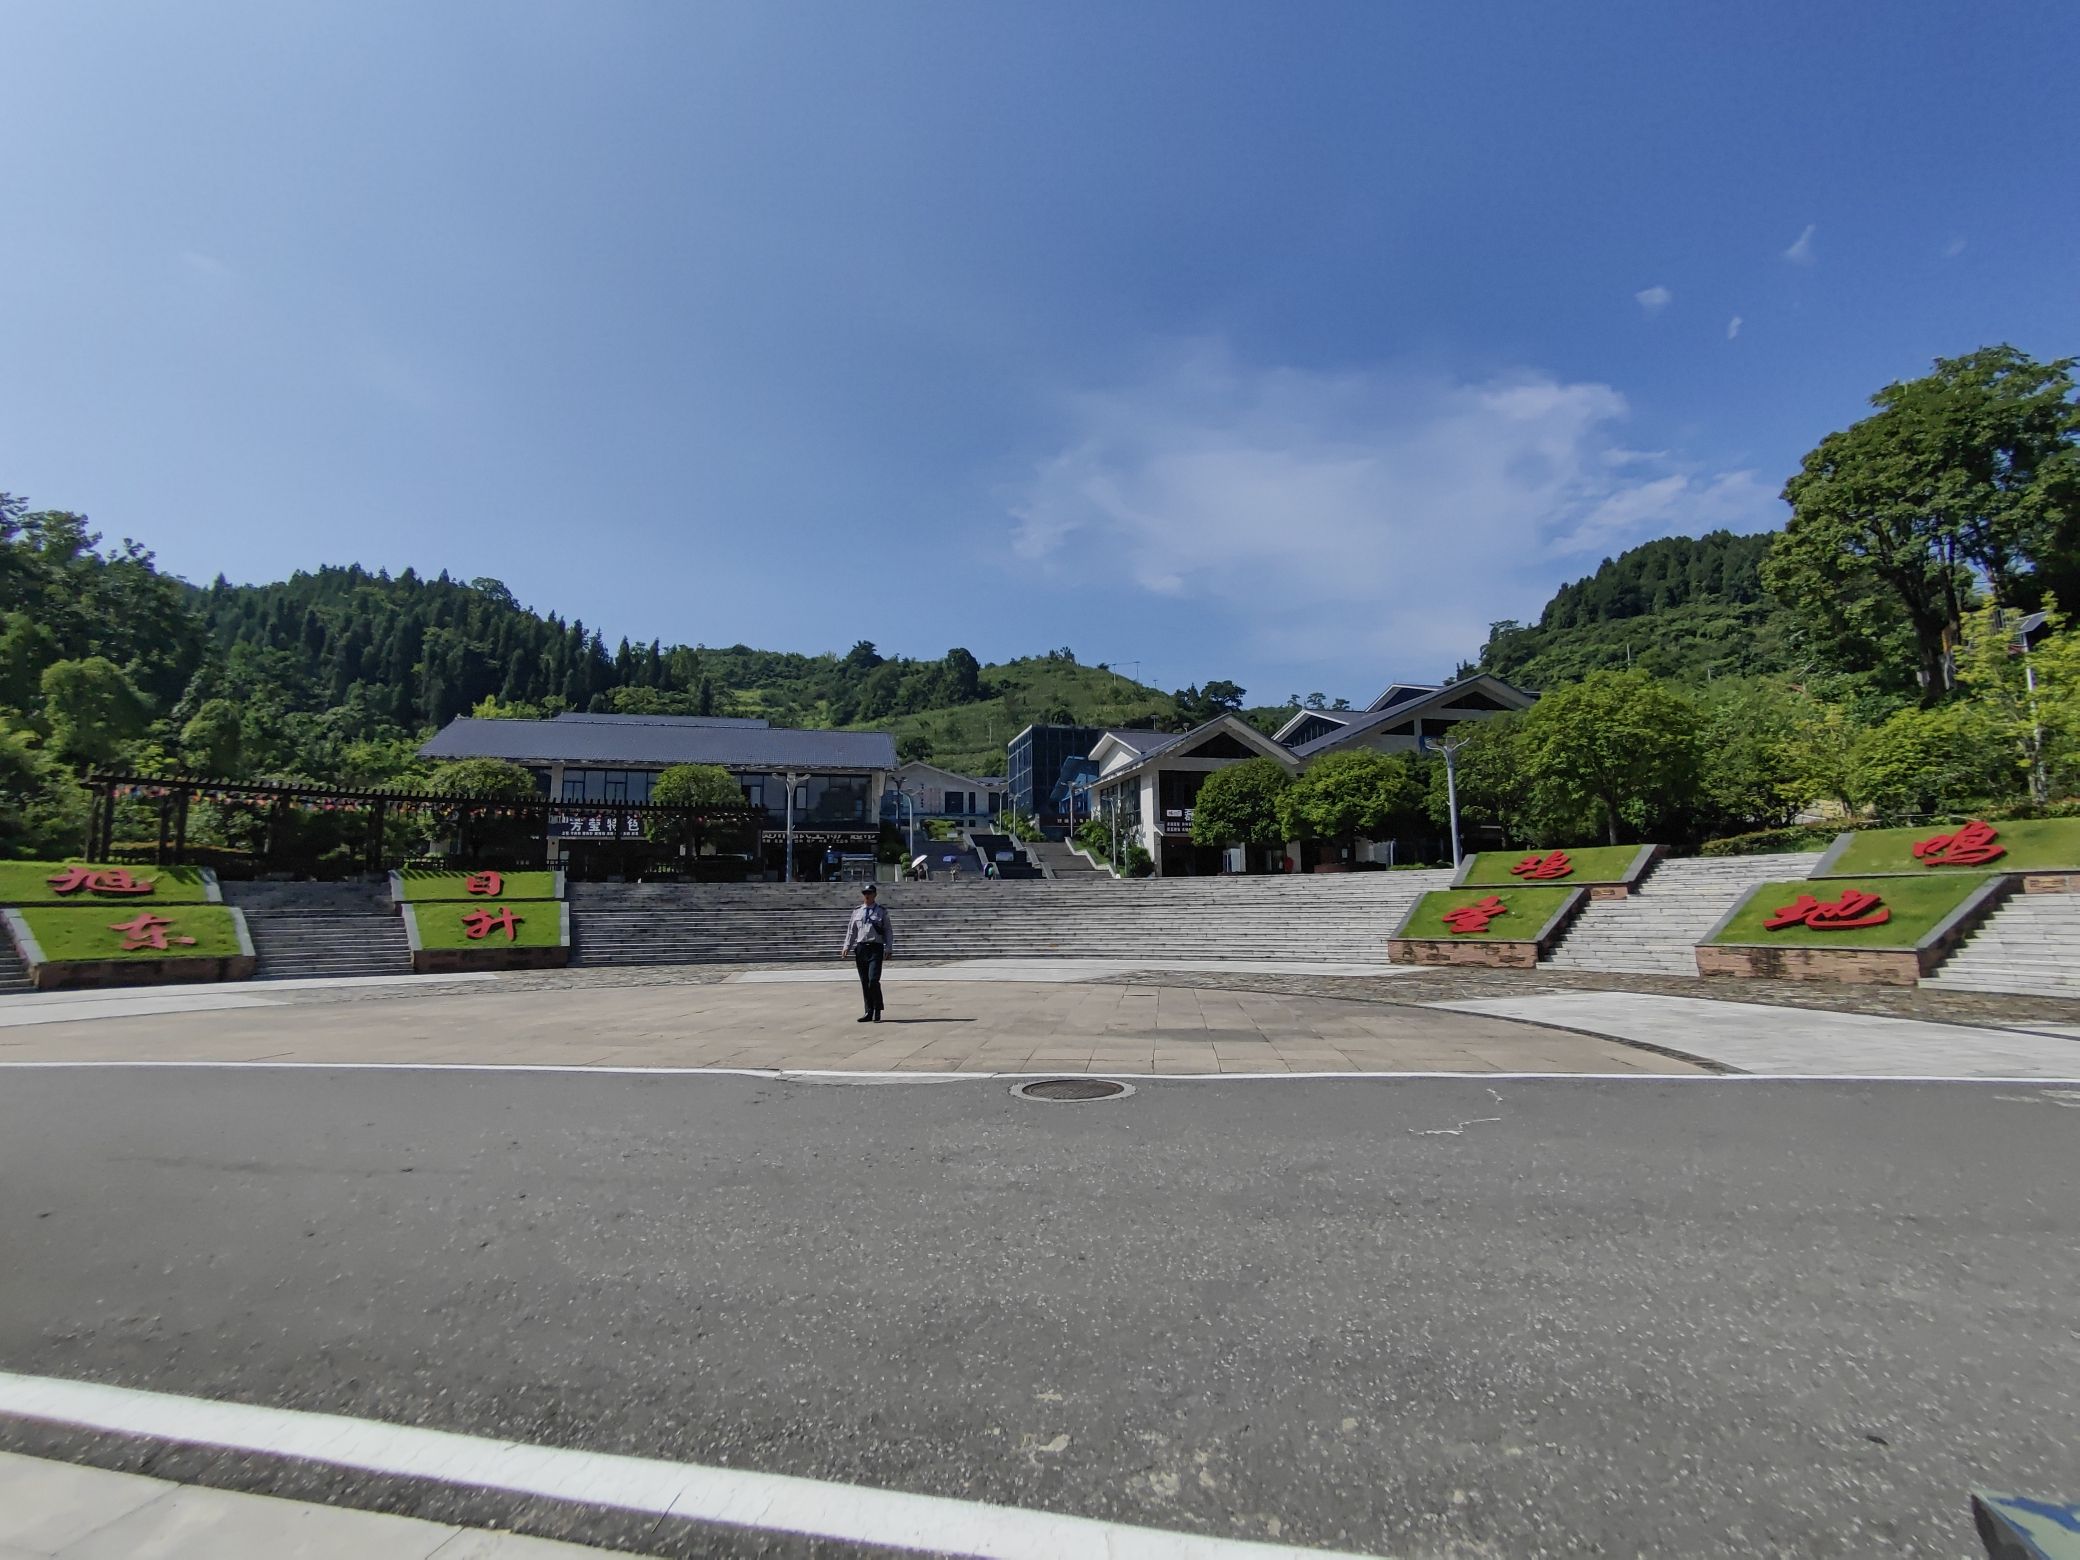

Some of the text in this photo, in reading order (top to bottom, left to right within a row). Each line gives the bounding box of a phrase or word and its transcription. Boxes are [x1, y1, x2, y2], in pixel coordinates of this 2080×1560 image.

[48, 866, 154, 893] 旭
[466, 870, 501, 896] 日
[1763, 889, 1890, 931] 地
[108, 913, 197, 950] 东
